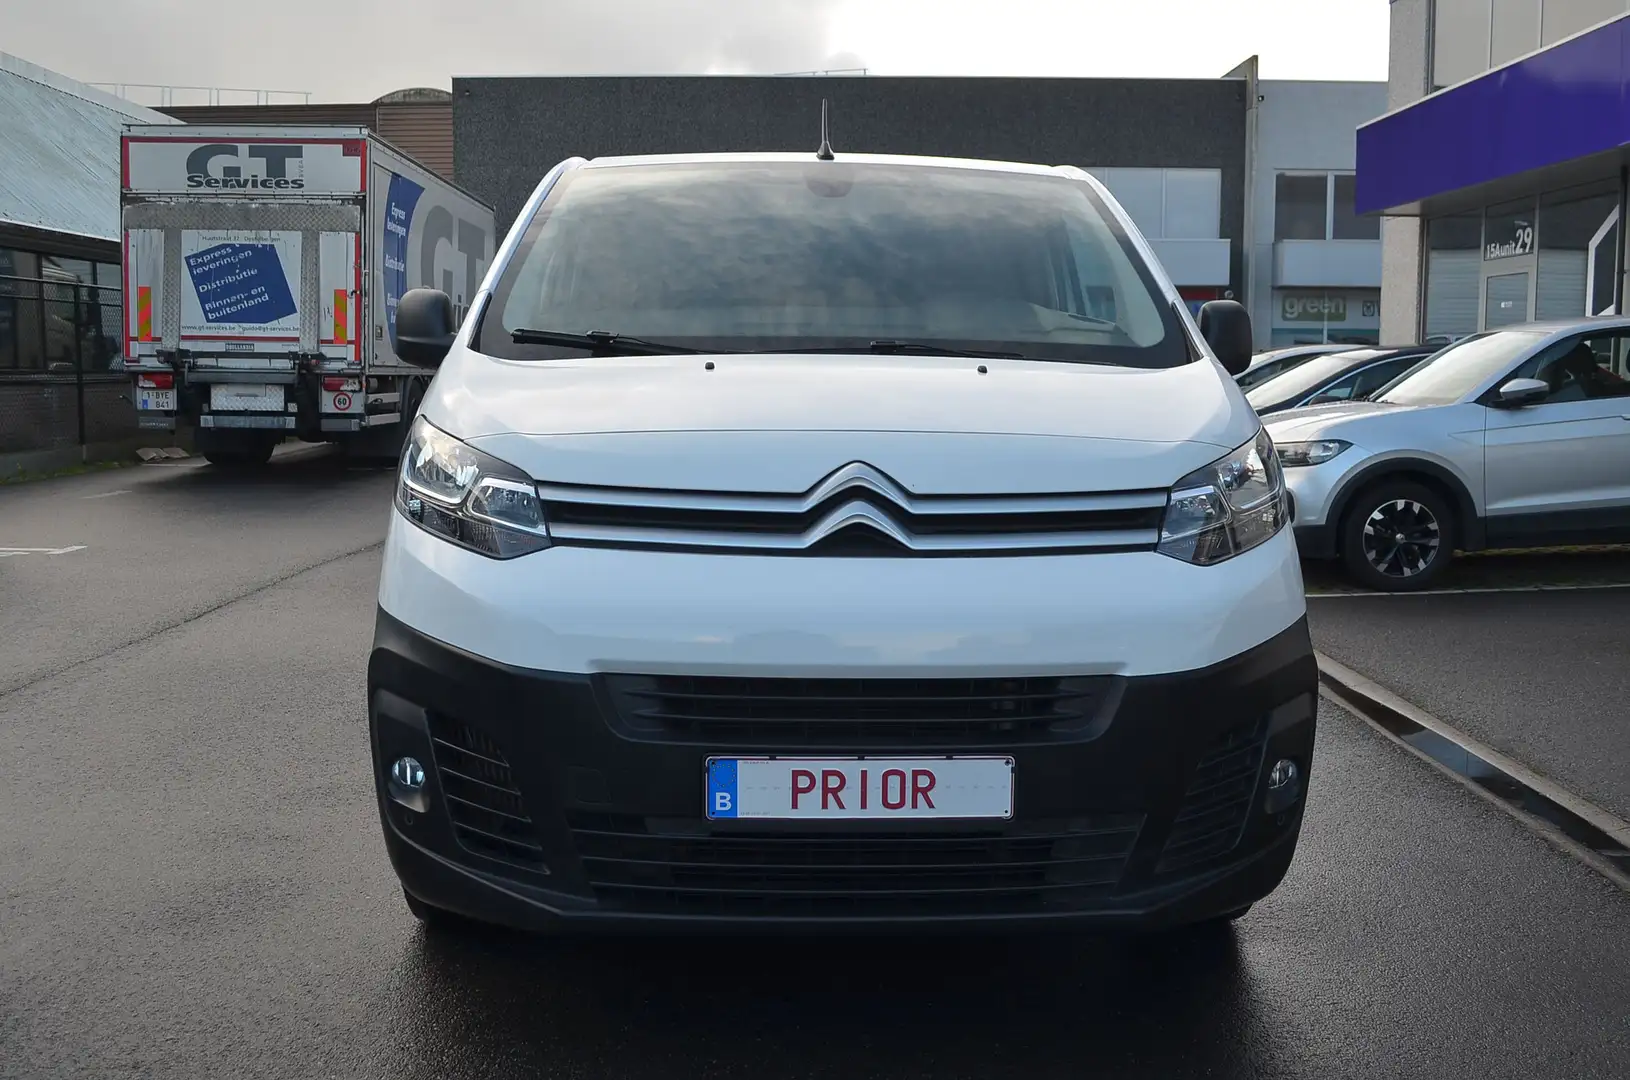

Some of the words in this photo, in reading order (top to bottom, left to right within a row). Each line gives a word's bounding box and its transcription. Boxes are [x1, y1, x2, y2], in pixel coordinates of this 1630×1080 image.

[186, 144, 303, 178] GT
[187, 174, 305, 189] Services
[189, 246, 232, 266] Express
[199, 268, 258, 293] Distributie
[250, 285, 266, 296] en
[207, 293, 269, 320] buitenland
[1284, 298, 1345, 318] green
[155, 400, 170, 409] 841
[337, 397, 347, 406] 60
[791, 769, 937, 809] PRIOR
[715, 792, 732, 811] B
